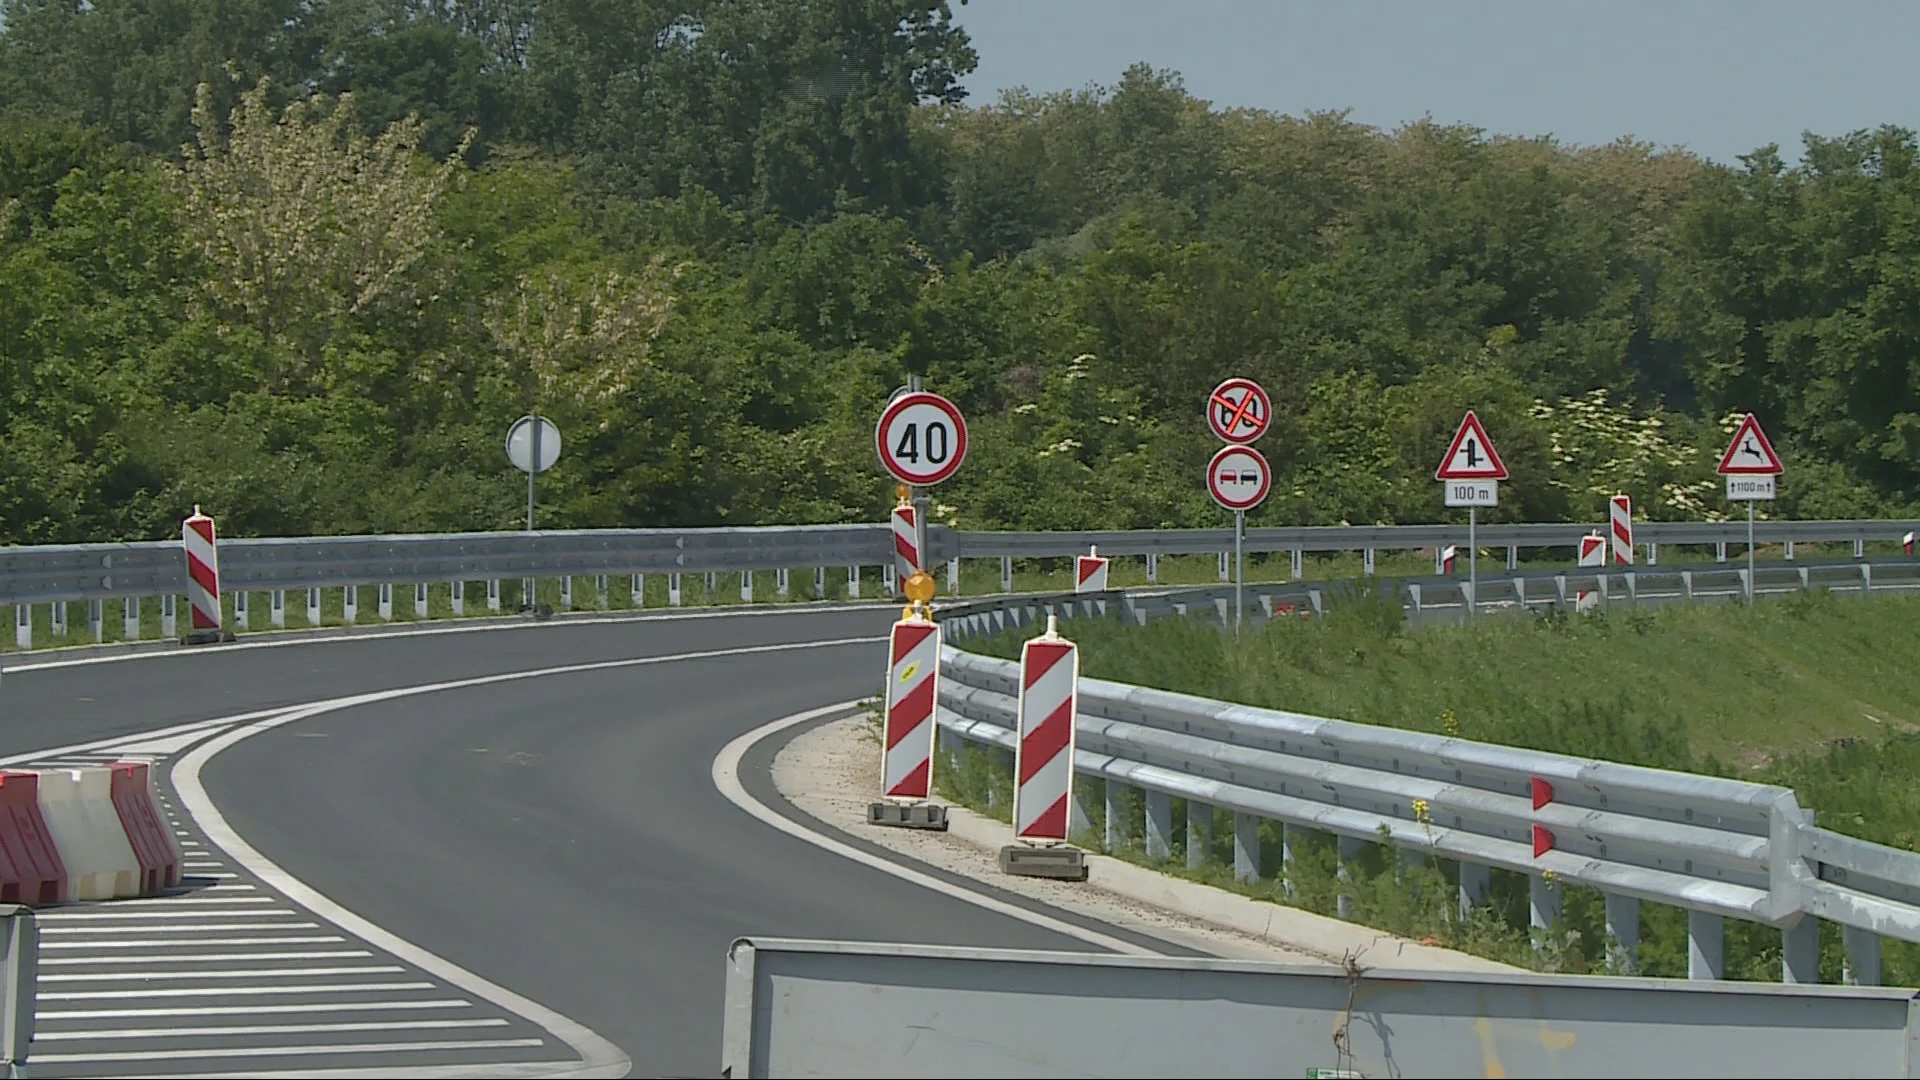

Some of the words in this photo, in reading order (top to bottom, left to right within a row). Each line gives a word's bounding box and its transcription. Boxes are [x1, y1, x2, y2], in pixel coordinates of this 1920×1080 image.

[896, 422, 947, 464] 40
[1454, 486, 1475, 500] 100
[1479, 489, 1489, 500] m
[1737, 481, 1756, 492] 1100
[1757, 484, 1765, 492] m
